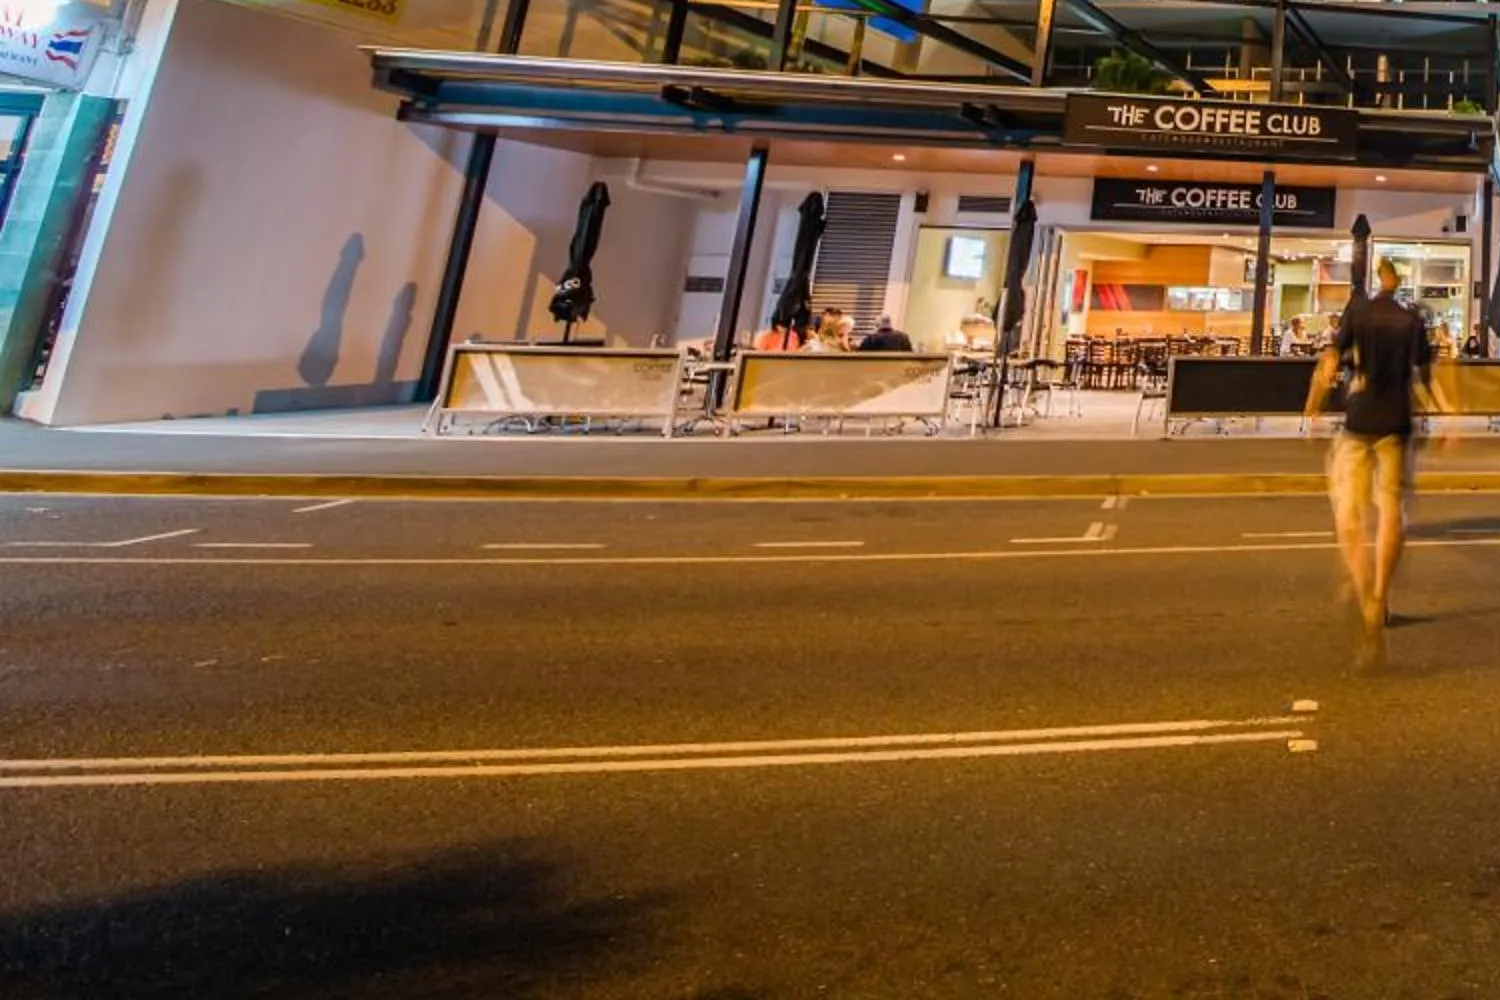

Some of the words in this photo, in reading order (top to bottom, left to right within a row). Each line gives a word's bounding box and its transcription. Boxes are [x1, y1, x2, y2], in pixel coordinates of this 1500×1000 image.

[1107, 104, 1150, 126] THE
[1154, 105, 1261, 135] COFFEE
[1267, 114, 1321, 136] CLUB
[1136, 188, 1168, 205] THE
[1171, 187, 1252, 209] COFFEE
[1256, 193, 1297, 209] CUB
